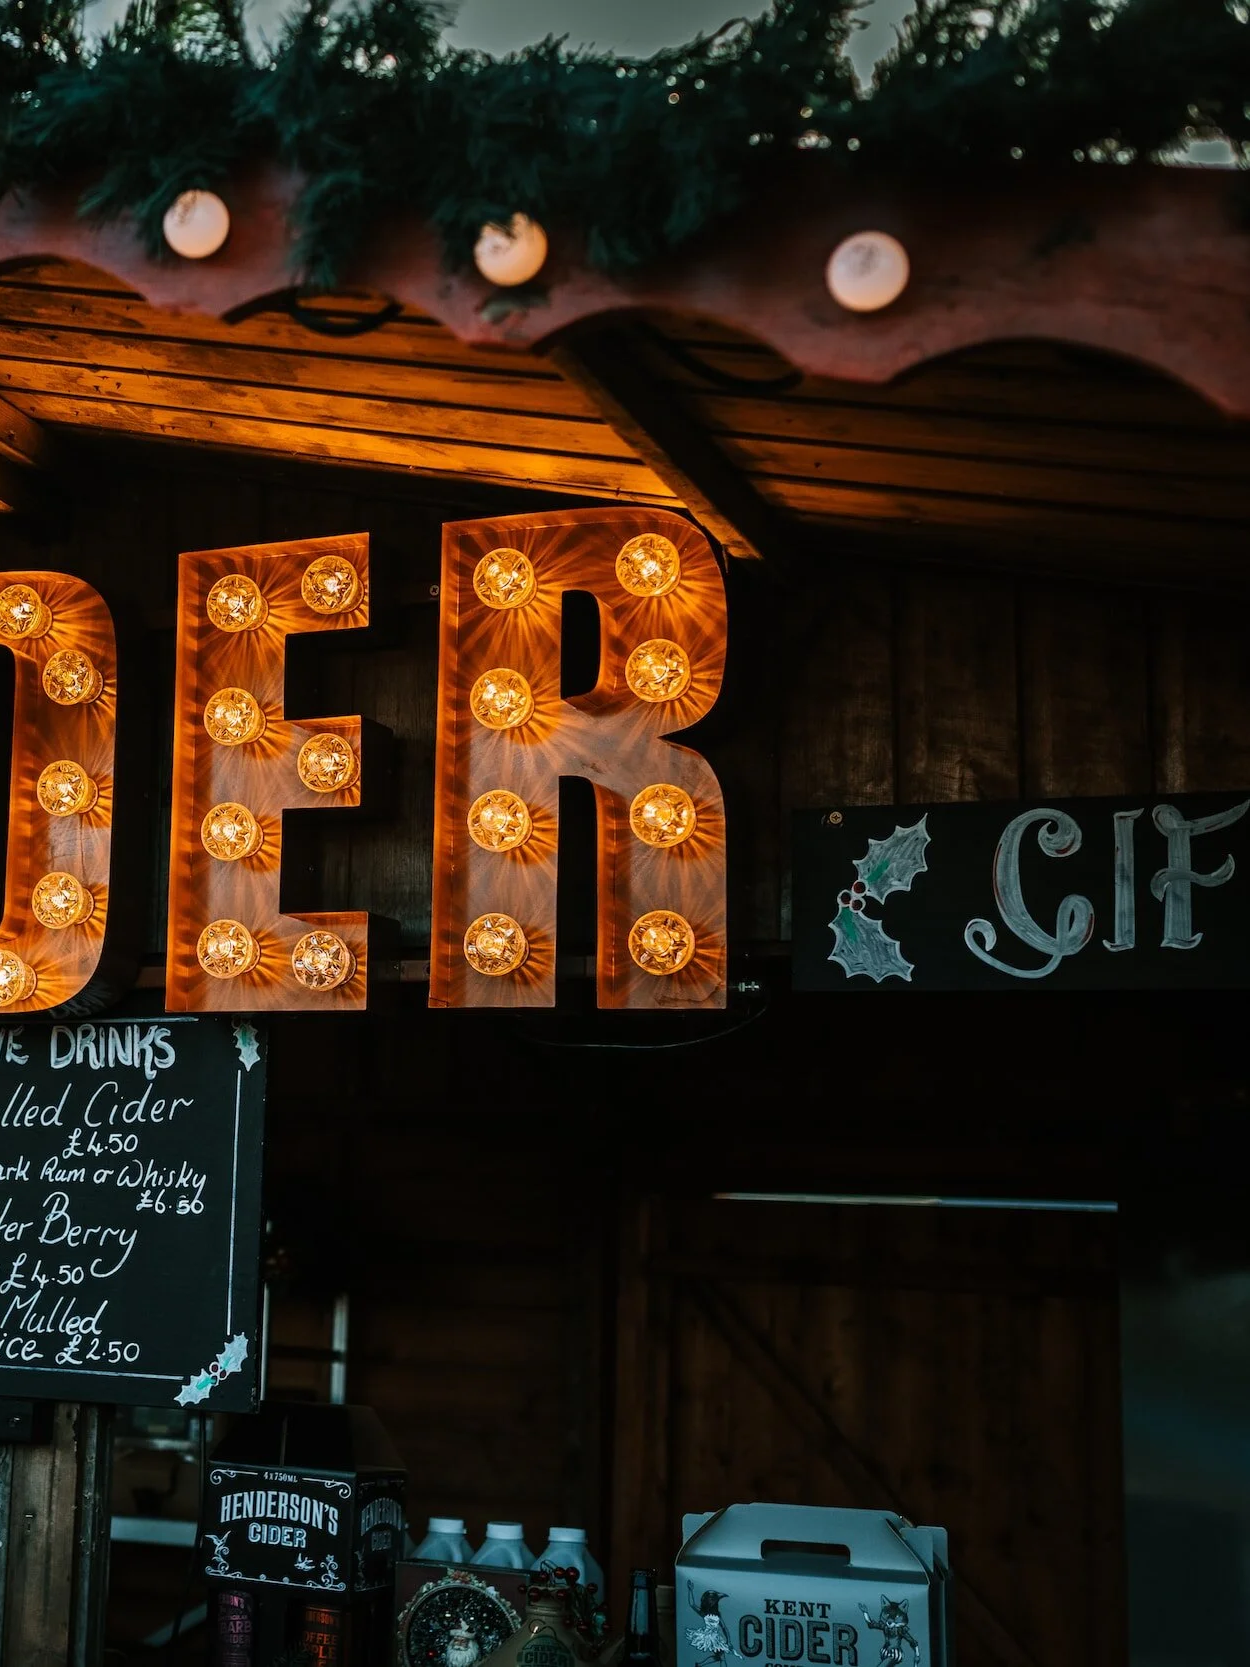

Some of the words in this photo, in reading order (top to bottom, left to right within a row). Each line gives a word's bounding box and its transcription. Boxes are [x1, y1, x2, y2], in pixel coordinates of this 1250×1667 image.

[49, 1023, 176, 1080] DRINKS
[83, 1080, 195, 1128] Cider
[61, 1127, 139, 1160] £4.50
[39, 1156, 86, 1183] Rum
[92, 1167, 115, 1185] or
[116, 1158, 208, 1202] Whisky
[135, 1188, 205, 1216] £6.50
[38, 1191, 139, 1279] Berry
[0, 1252, 85, 1295] £4.50
[0, 1288, 110, 1336] Mulled
[54, 1333, 142, 1366] £2.50
[219, 1489, 340, 1538] HENDERSON'S
[247, 1521, 308, 1550] CIDER
[764, 1598, 831, 1619] KENT
[524, 1651, 568, 1667] CIDER
[739, 1614, 859, 1667] CIDER
